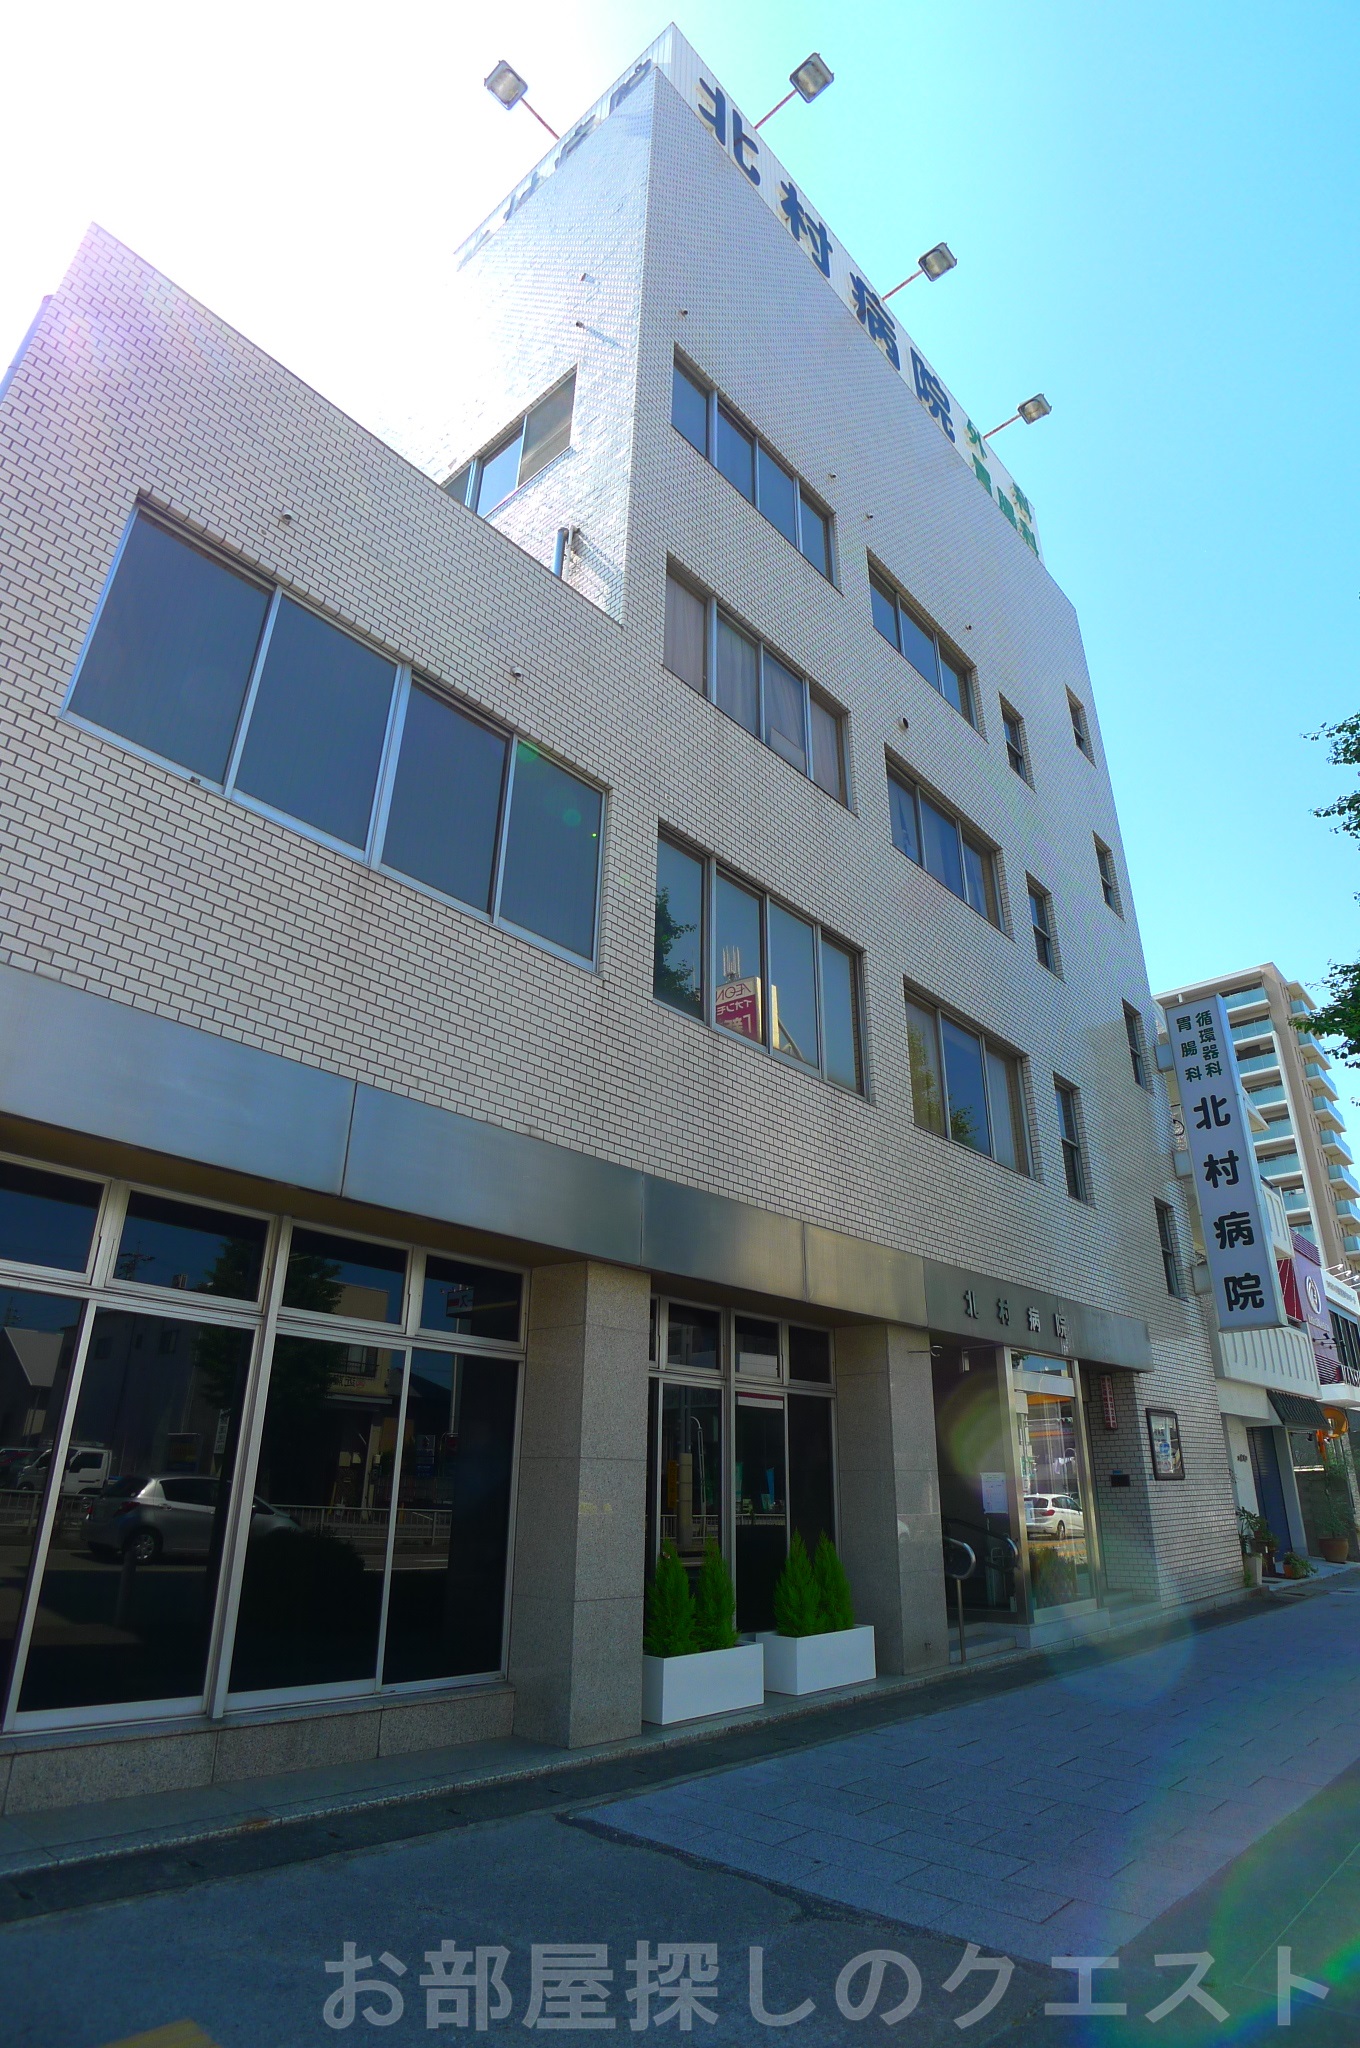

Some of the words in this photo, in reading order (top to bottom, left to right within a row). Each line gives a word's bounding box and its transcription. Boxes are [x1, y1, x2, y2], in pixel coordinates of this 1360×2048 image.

[698, 77, 956, 443] 北村病院
[1176, 1015, 1202, 1082] 胃腸科
[1195, 1010, 1222, 1077] 循環器科
[1193, 1094, 1265, 1312] 北村病院
[963, 1289, 1068, 1339] 北村病院
